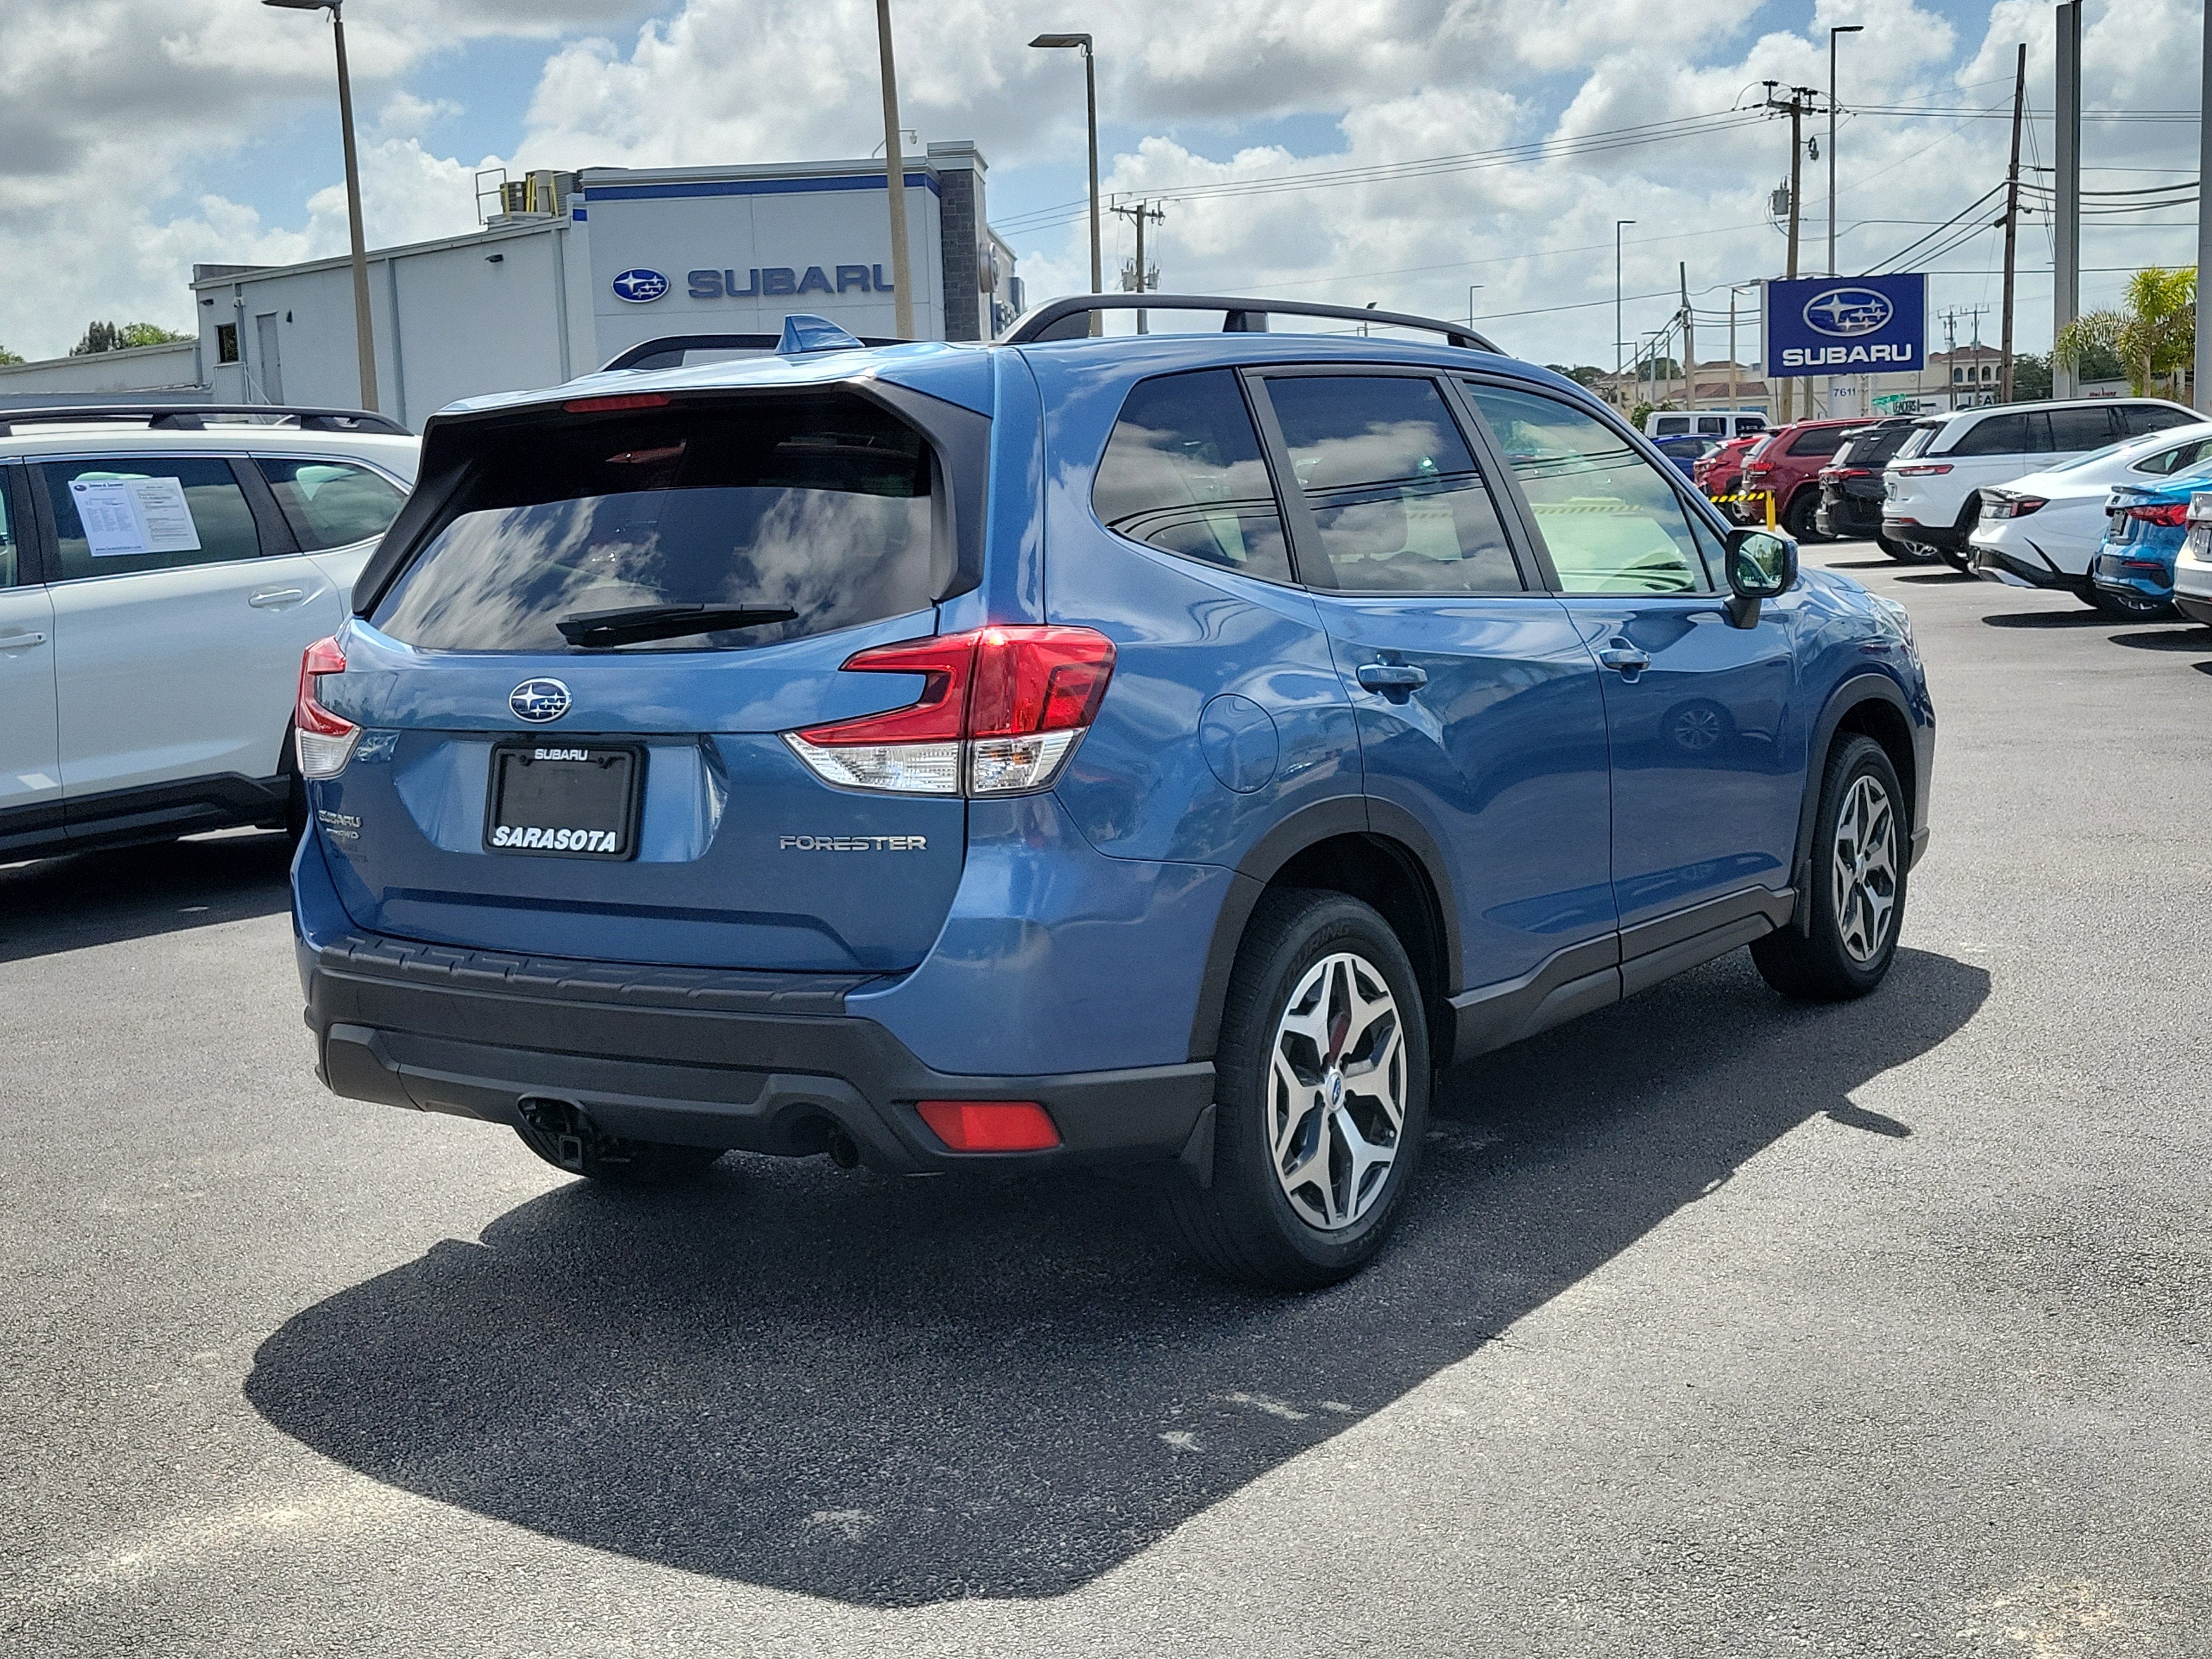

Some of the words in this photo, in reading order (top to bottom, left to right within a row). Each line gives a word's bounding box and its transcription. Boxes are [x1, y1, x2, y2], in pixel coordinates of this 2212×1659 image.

[1782, 343, 1912, 366] SUBARU
[1833, 388, 1856, 397] 7611
[534, 749, 588, 761] SUBARU
[493, 826, 616, 852] SARASOTA
[780, 836, 927, 850] FORESTER
